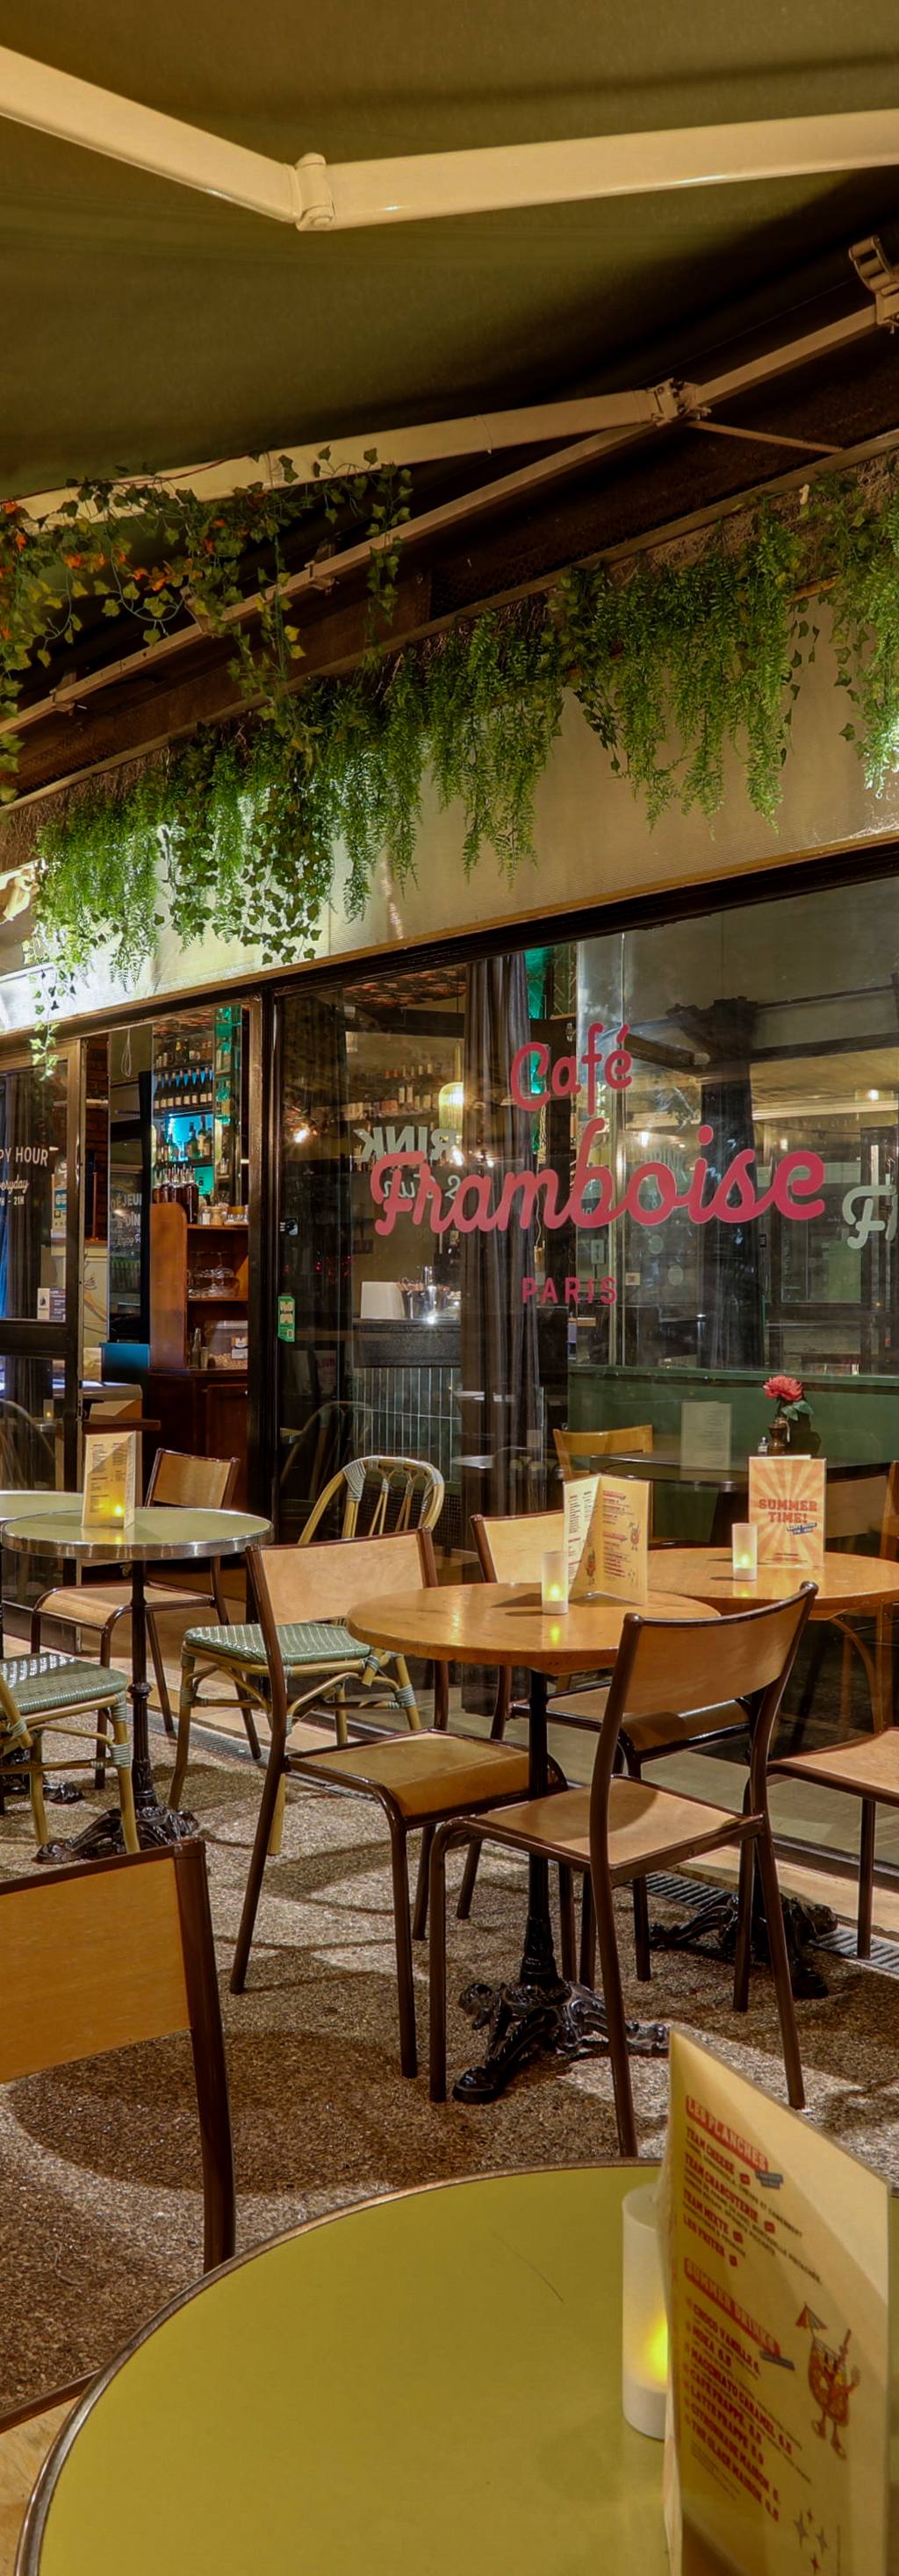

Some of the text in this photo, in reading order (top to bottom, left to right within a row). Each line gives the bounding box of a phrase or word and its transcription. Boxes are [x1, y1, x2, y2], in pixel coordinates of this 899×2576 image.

[511, 1023, 632, 1116] Café
[16, 1146, 48, 1167] HOUR
[370, 1118, 825, 1236] Framboise
[521, 1276, 618, 1304] PARIS
[758, 1498, 818, 1511] SUMMER
[768, 1511, 809, 1524] TIME!
[687, 2094, 705, 2123] LES
[708, 2113, 766, 2174] PLANCHES
[687, 2125, 704, 2150] TEAM
[707, 2142, 734, 2175] CHEESE
[684, 2188, 702, 2213] TEAM
[685, 2151, 703, 2178] TEAM
[705, 2170, 758, 2224] CHARCUTERIE
[687, 2258, 730, 2314] SUMMER
[693, 2323, 714, 2353] MOKA
[694, 2301, 717, 2334] CHOCO
[691, 2346, 737, 2399] MACCHIATO
[739, 2392, 774, 2438] CARAMEL
